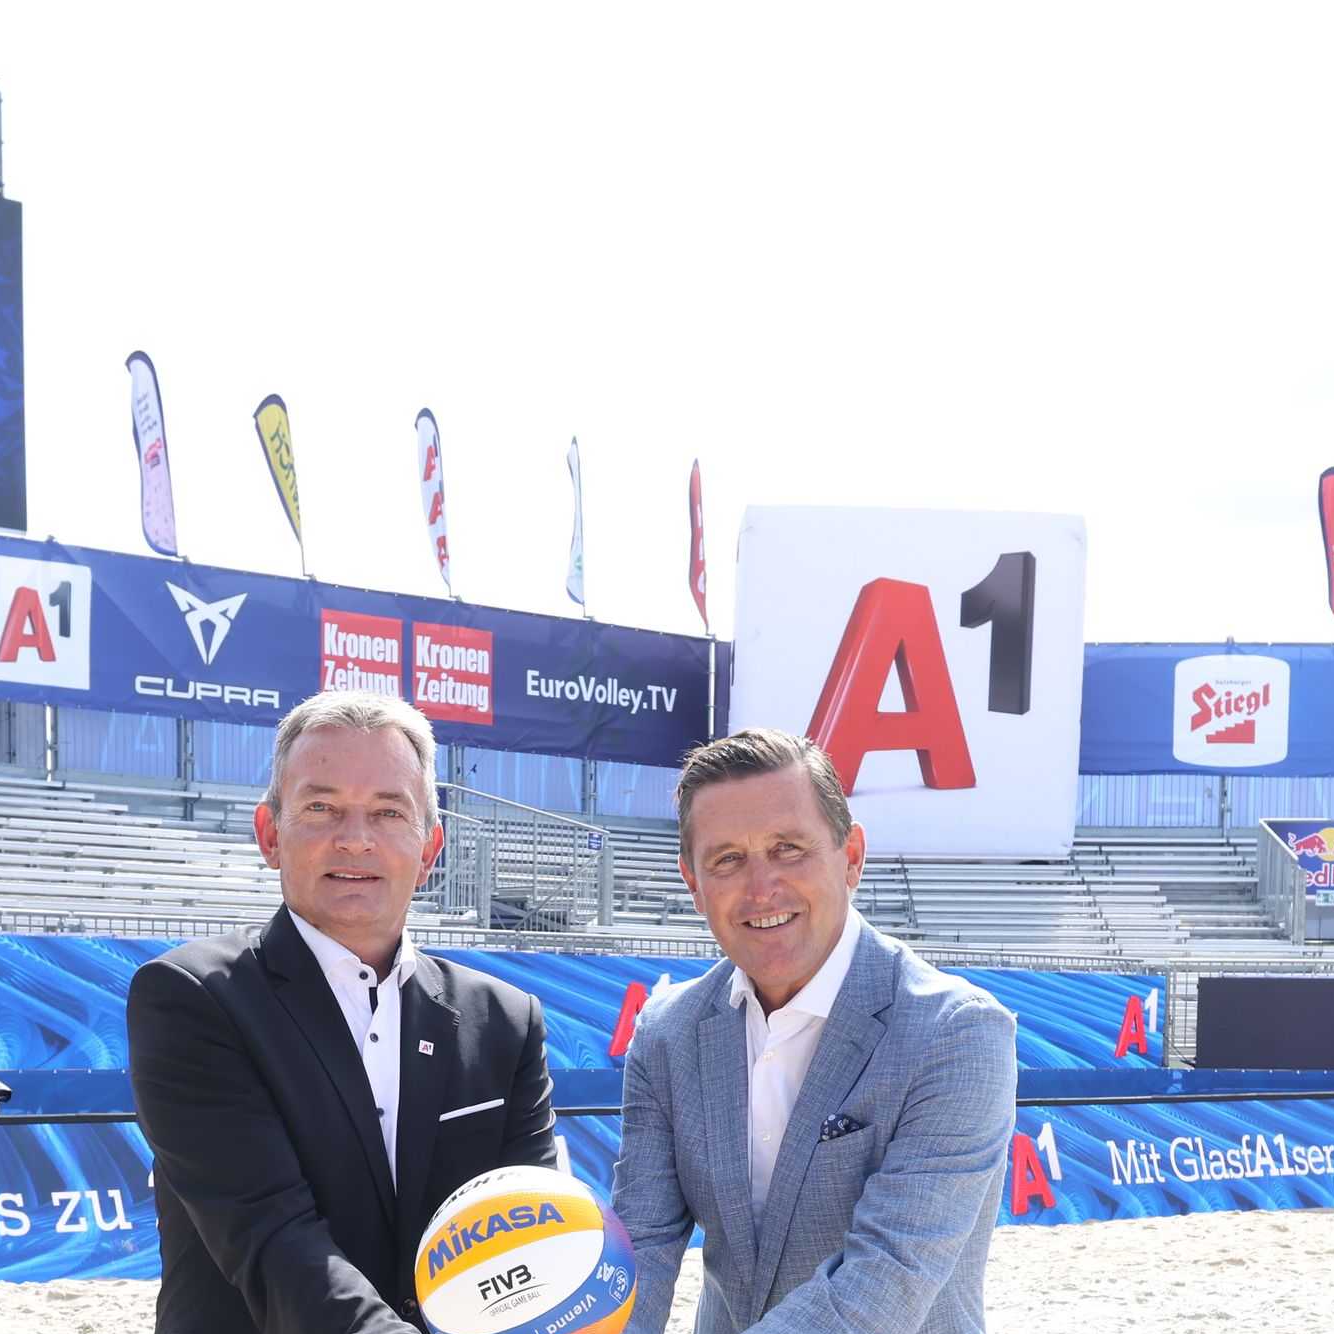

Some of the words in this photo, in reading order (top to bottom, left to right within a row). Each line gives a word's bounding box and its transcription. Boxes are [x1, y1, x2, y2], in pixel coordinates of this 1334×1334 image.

[324, 622, 399, 664] Kronen
[416, 635, 489, 675] Kronen
[135, 675, 279, 709] CUPRA
[416, 671, 489, 713] Zeitung
[526, 669, 677, 714] EuroVolley.TV
[805, 551, 1037, 797] A1
[1191, 682, 1270, 733] Stiegl
[1305, 863, 1330, 887] ed
[1114, 988, 1159, 1058] A1
[1012, 1122, 1062, 1216] A1
[1106, 1139, 1165, 1186] Mit
[52, 1188, 132, 1234] zu
[478, 1264, 532, 1301] FIVB
[489, 1302, 512, 1317] OFFICIAL
[510, 1294, 528, 1308] GAME
[526, 1291, 541, 1301] BALL
[546, 1293, 597, 1334] Vienna
